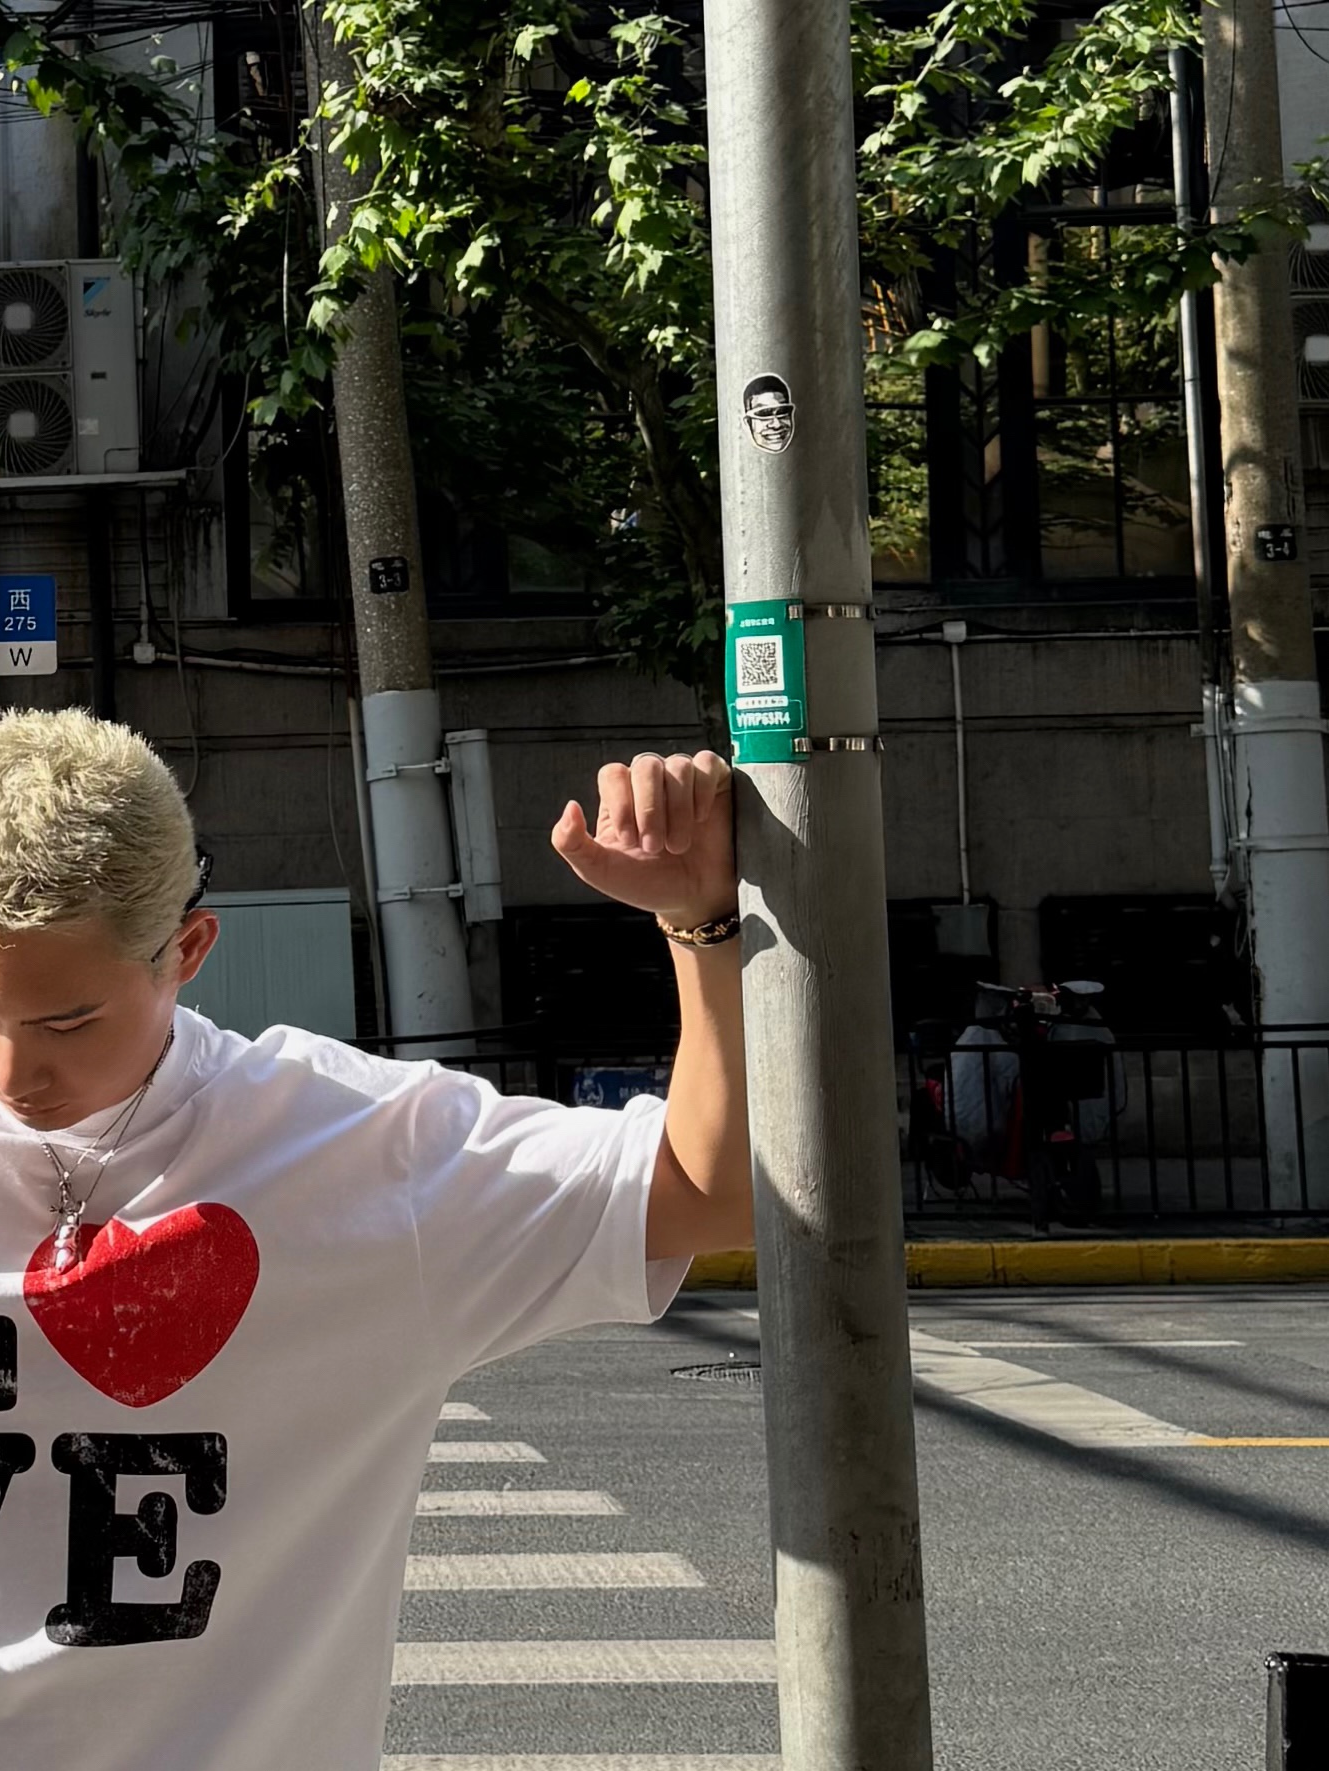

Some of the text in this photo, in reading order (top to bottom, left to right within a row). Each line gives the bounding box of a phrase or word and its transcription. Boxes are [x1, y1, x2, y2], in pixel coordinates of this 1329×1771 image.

[378, 572, 402, 588] 3-3
[7, 588, 32, 612] 西
[3, 616, 37, 632] 275
[9, 647, 33, 667] W
